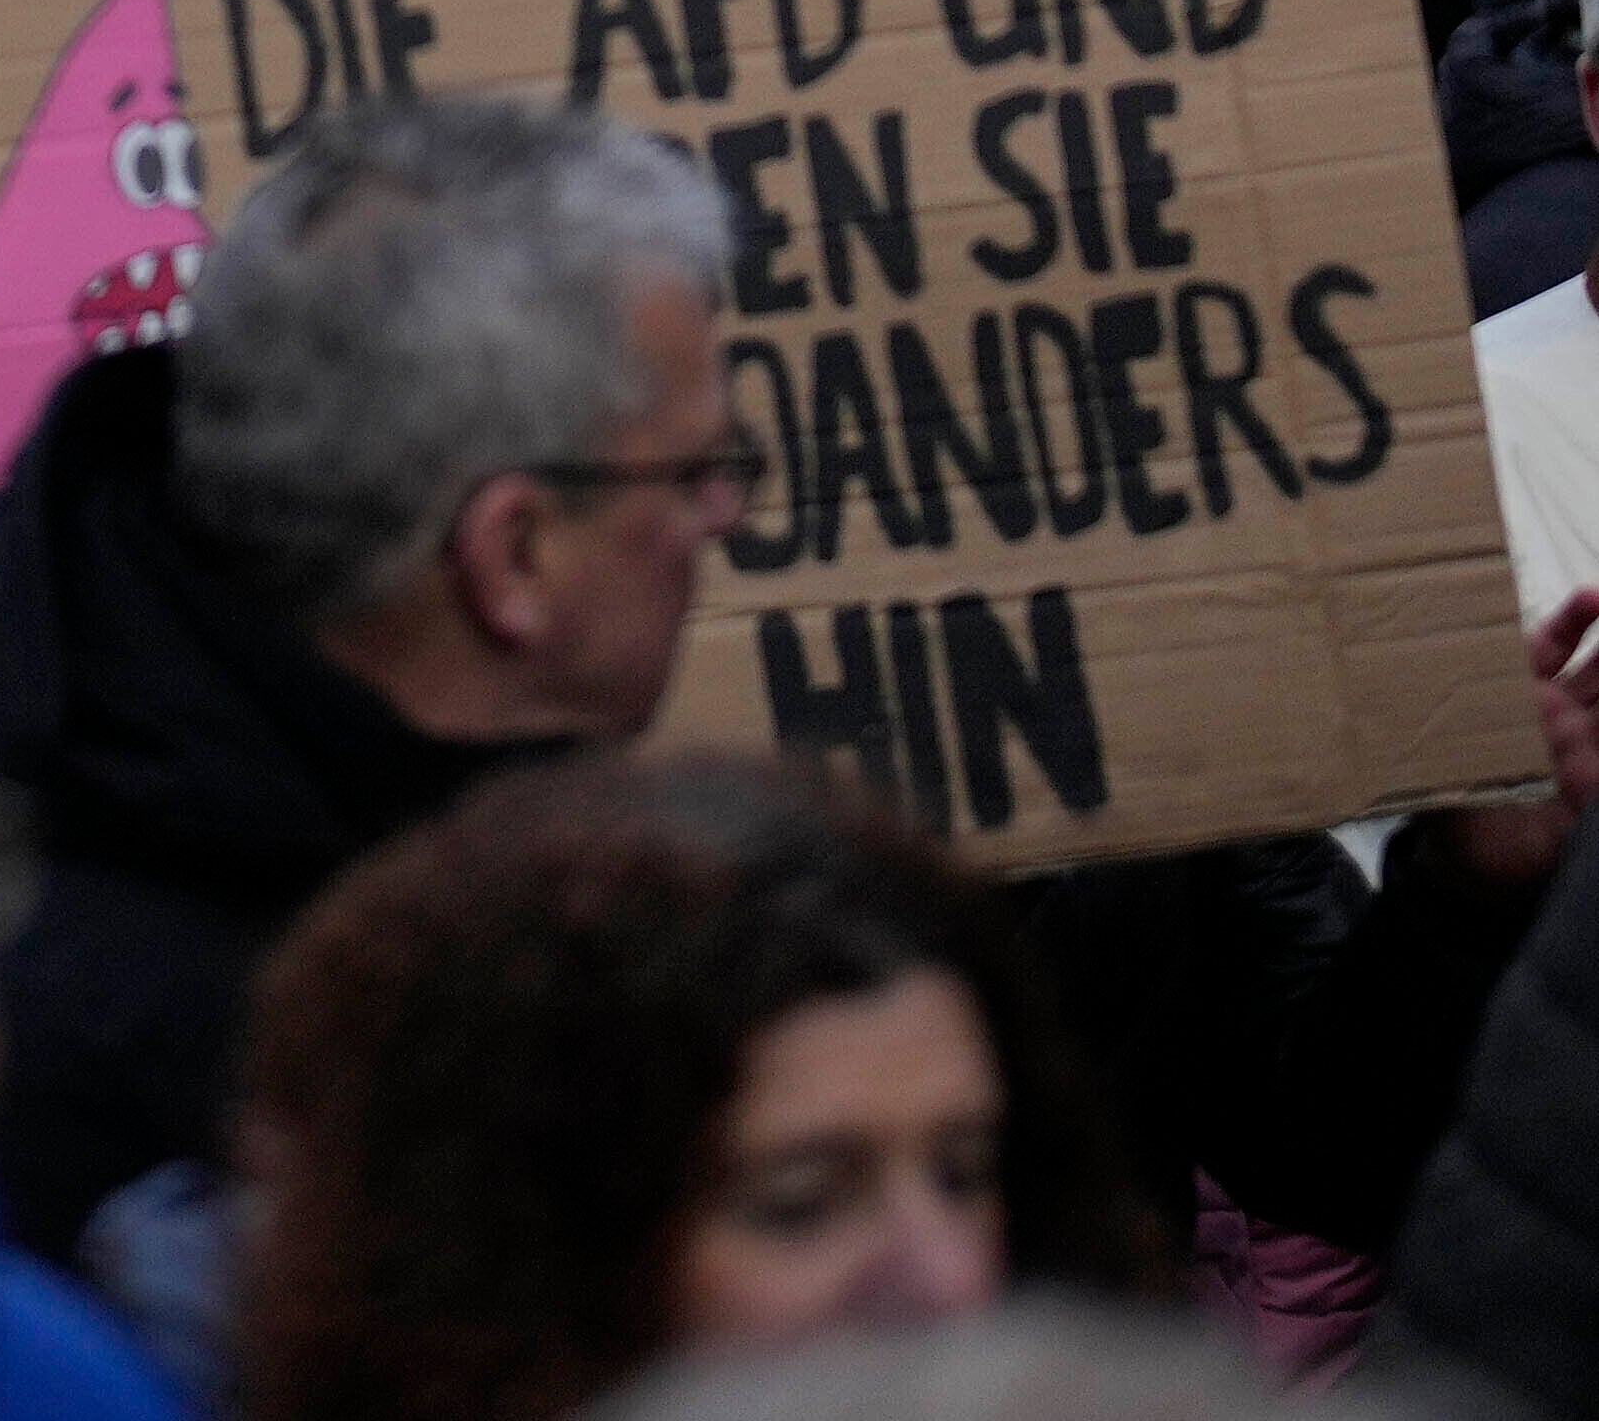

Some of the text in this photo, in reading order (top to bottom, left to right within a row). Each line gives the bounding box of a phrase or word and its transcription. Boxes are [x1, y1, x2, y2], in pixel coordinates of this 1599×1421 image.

[971, 81, 1194, 284] SIE
[717, 263, 1395, 575] OANDERS
[756, 587, 1110, 837] HIN
